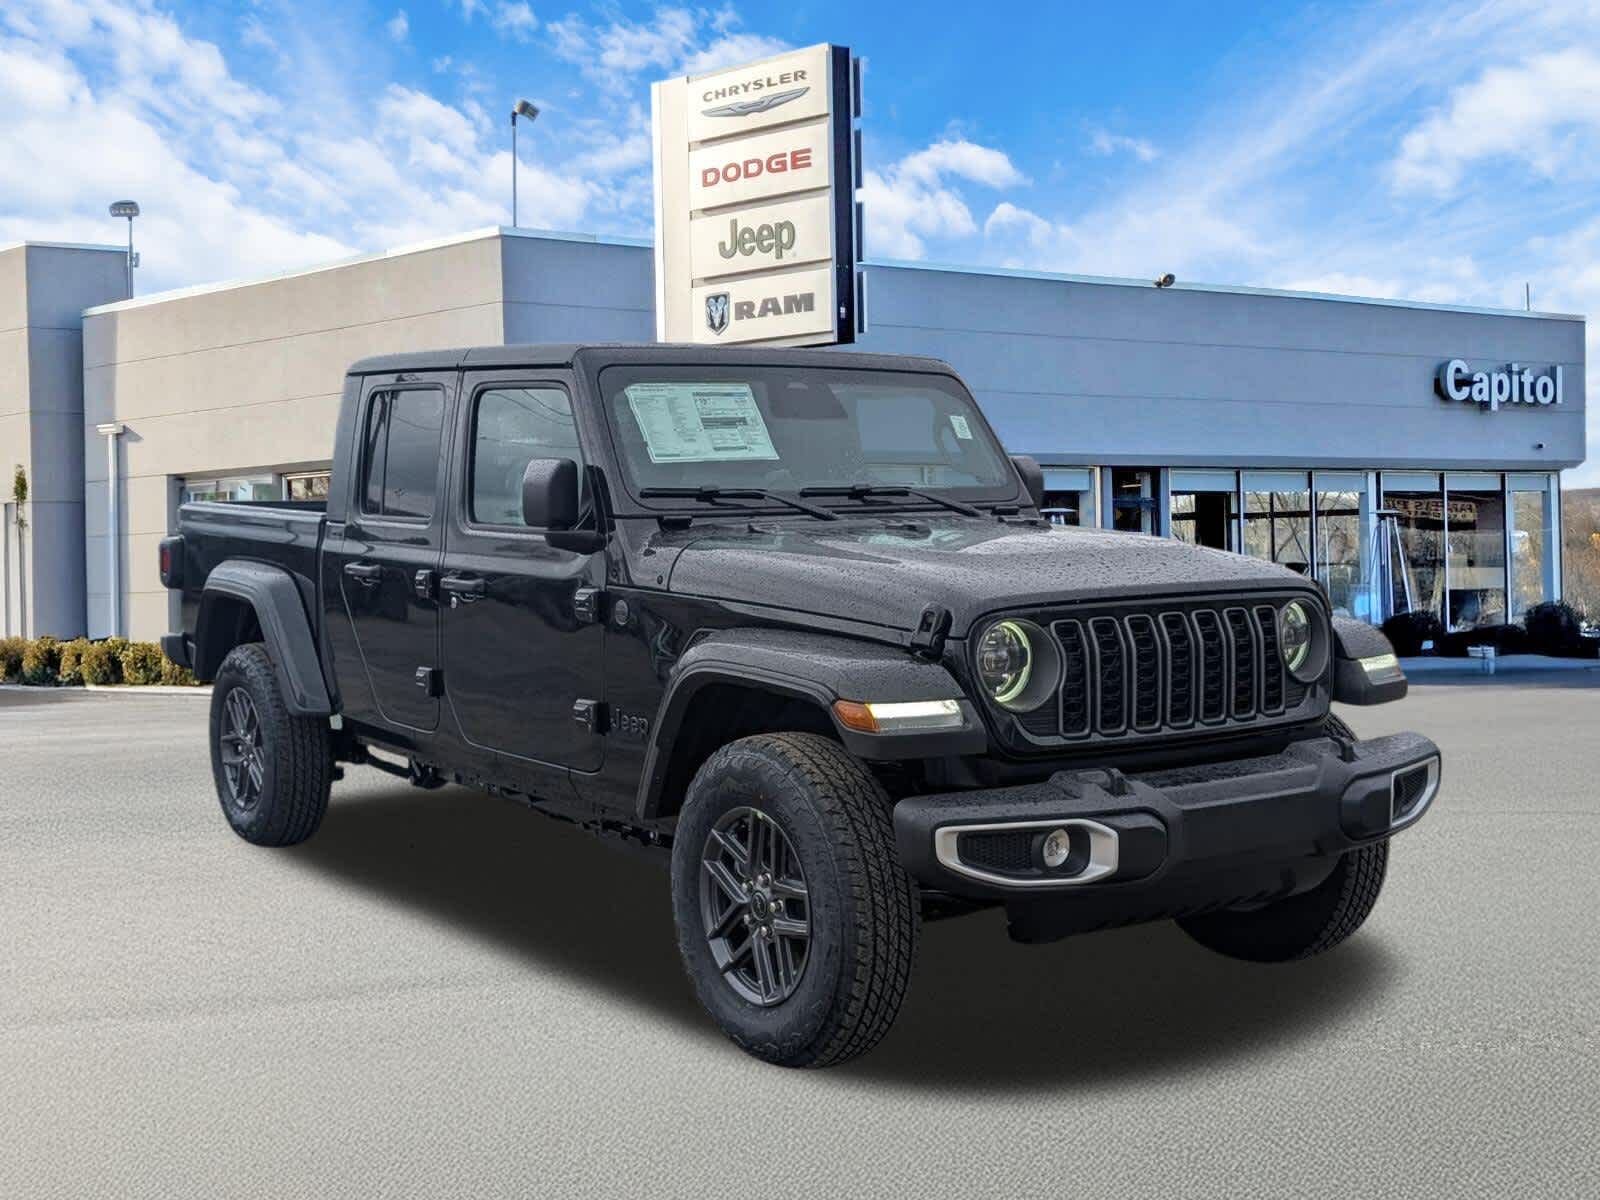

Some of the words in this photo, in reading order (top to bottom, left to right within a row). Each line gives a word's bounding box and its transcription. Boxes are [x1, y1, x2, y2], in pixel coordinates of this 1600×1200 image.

[702, 69, 808, 103] CHRYSLER
[701, 148, 812, 188] DODGE
[718, 218, 796, 260] Jeep
[733, 292, 815, 321] RAM
[1444, 358, 1564, 412] Capitol
